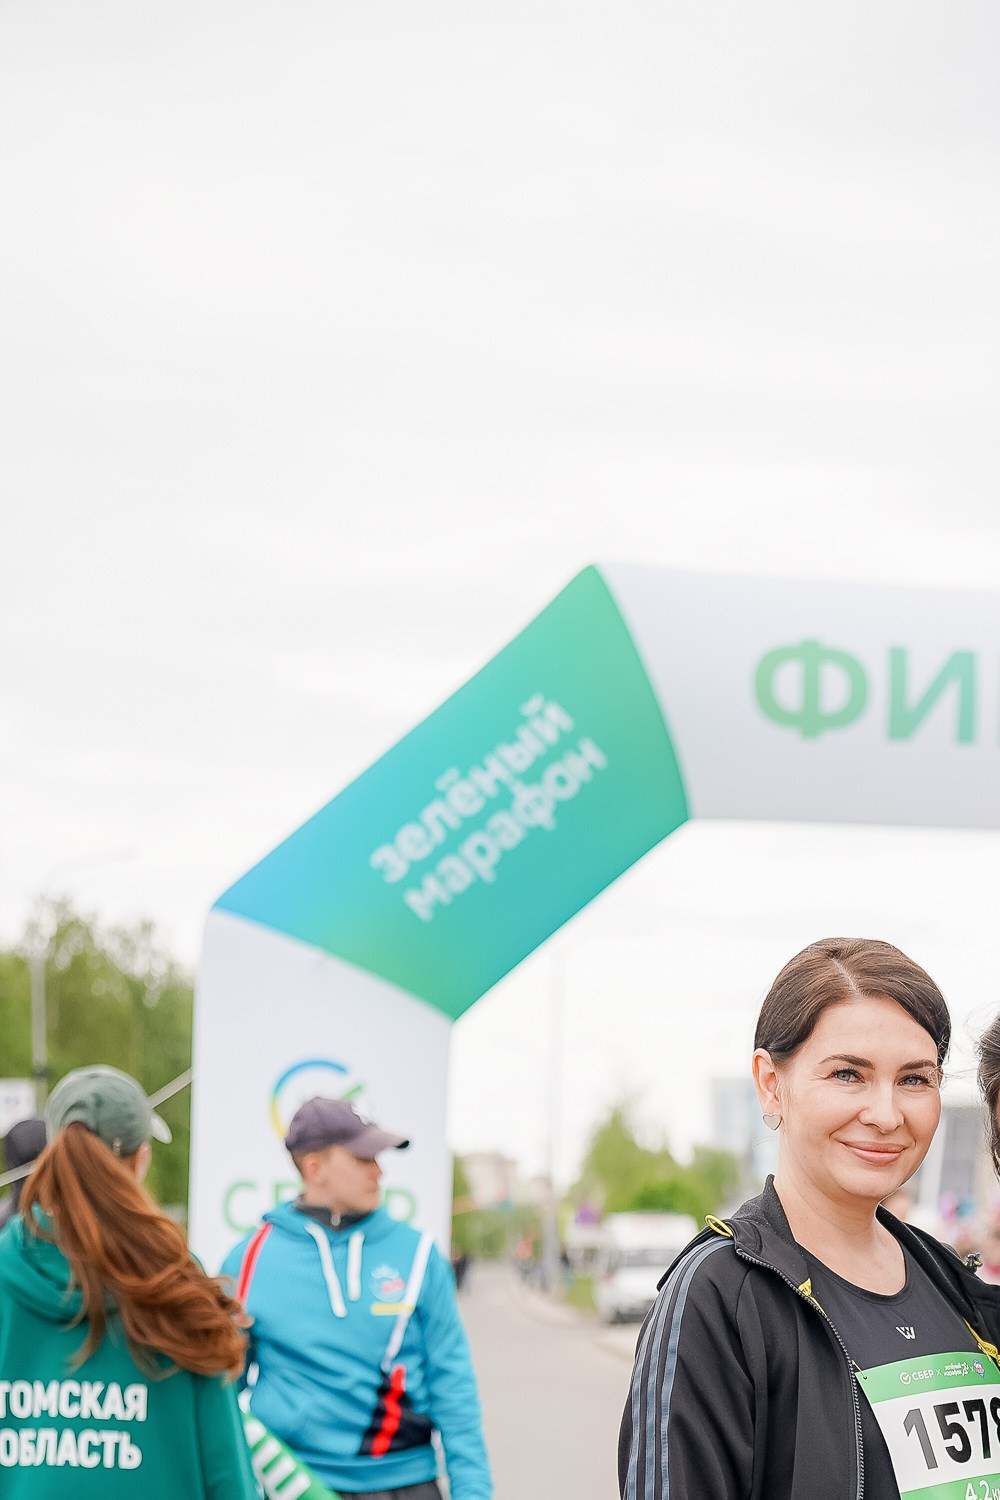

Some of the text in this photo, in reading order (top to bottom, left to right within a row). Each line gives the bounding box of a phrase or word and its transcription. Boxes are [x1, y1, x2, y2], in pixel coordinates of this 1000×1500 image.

[403, 736, 608, 922] марафон
[911, 1369, 934, 1381] СБЕР
[0, 1427, 142, 1470] ОБЛАСТЬ
